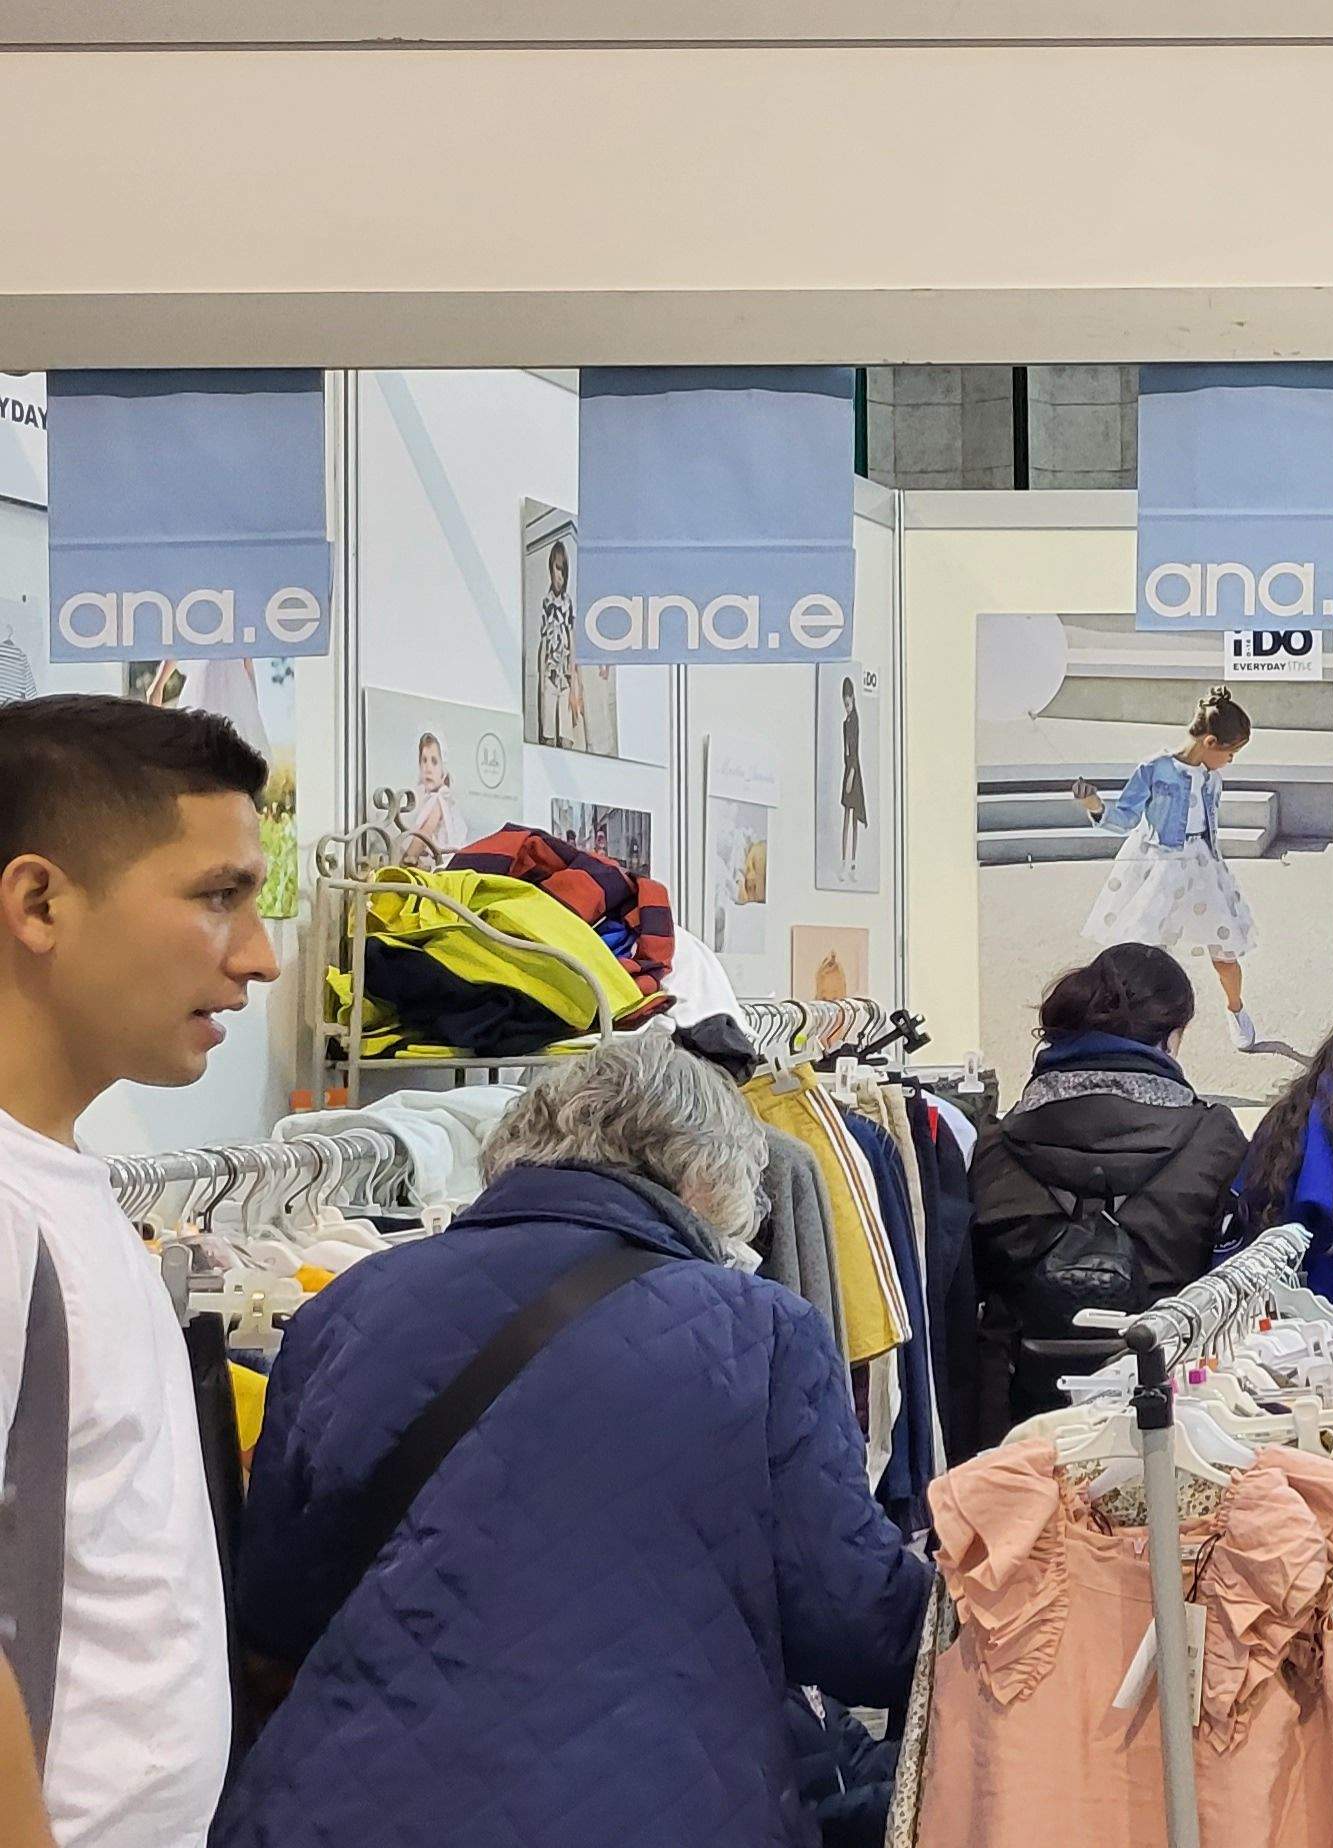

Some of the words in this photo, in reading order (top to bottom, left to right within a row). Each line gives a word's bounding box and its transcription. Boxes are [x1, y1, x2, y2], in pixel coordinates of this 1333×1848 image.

[58, 586, 321, 649] ana.e
[584, 593, 845, 652] ana.e
[1233, 662, 1286, 672] EVERYDAY
